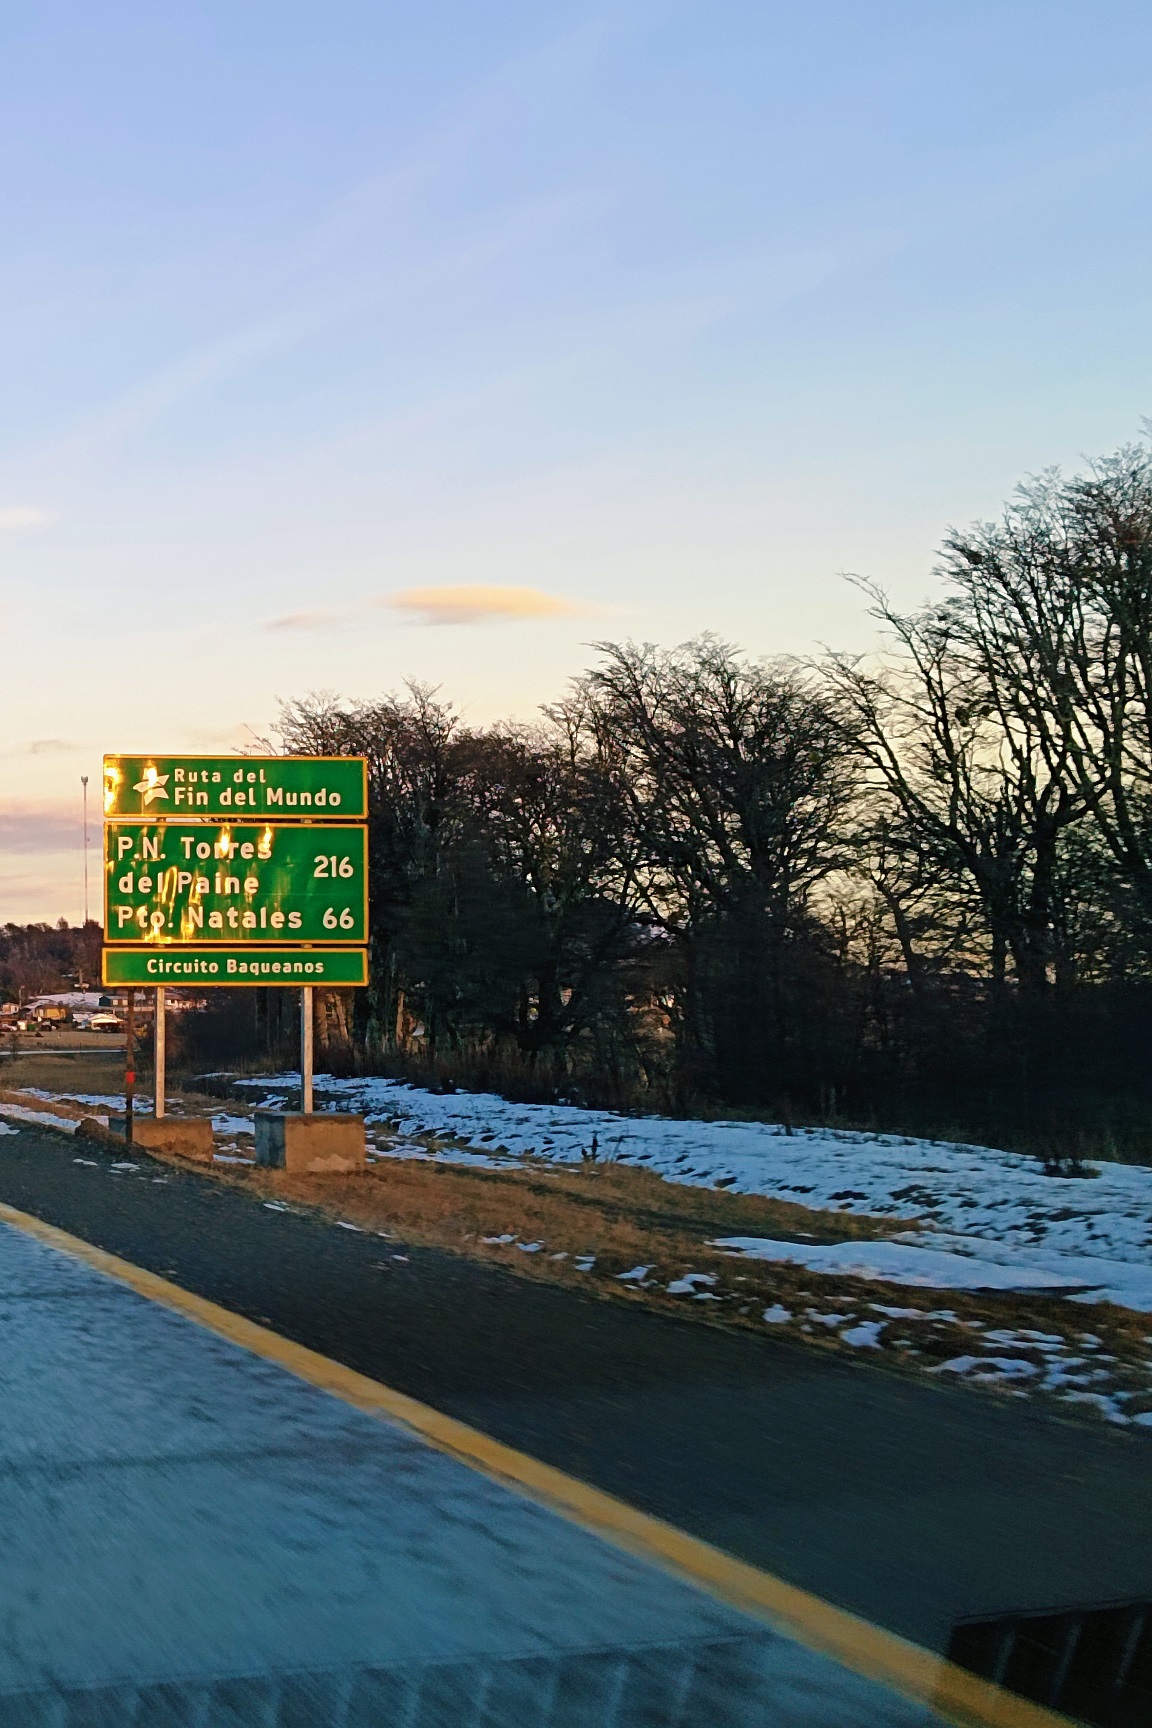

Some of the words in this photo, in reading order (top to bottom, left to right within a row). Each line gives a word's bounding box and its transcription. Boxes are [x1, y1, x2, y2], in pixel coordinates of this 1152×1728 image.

[174, 768, 221, 783] Ruta
[233, 768, 266, 783] del
[174, 787, 208, 806] Fin
[219, 788, 256, 806] del
[266, 787, 341, 806] Mundo
[117, 836, 166, 860] P.N.
[180, 836, 272, 860] Torres
[313, 855, 354, 878] 216
[118, 871, 163, 894] del
[177, 871, 259, 894] Paine
[117, 905, 174, 928] Pto.
[188, 906, 302, 929] Natales
[322, 907, 355, 929] 66
[147, 959, 219, 973] Circuito
[226, 959, 324, 975] Baqueanos
